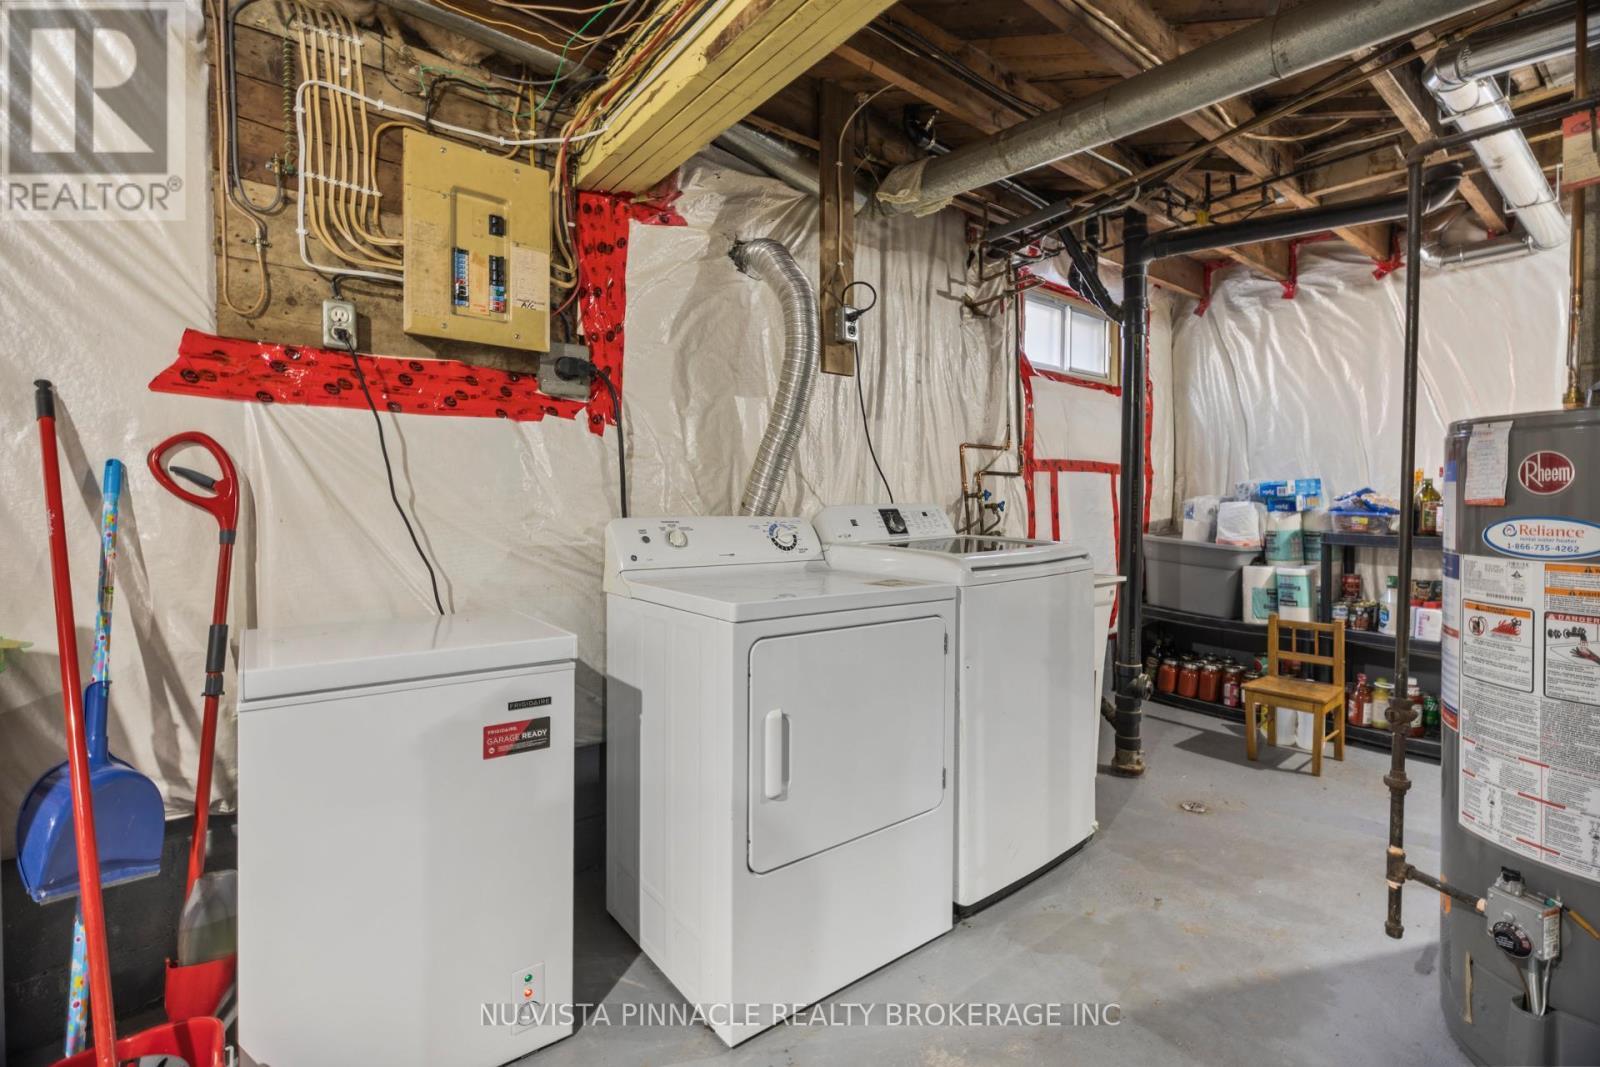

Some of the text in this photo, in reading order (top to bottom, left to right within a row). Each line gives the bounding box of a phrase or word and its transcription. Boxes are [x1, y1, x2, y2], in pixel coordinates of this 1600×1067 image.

[1525, 452, 1570, 488] Rheem
[1520, 524, 1585, 539] Reliance
[1507, 542, 1580, 553] 1-866-735-4262
[509, 698, 550, 709] FRIGIDAIRE
[486, 733, 520, 746] GARAGE
[521, 729, 548, 740] READY
